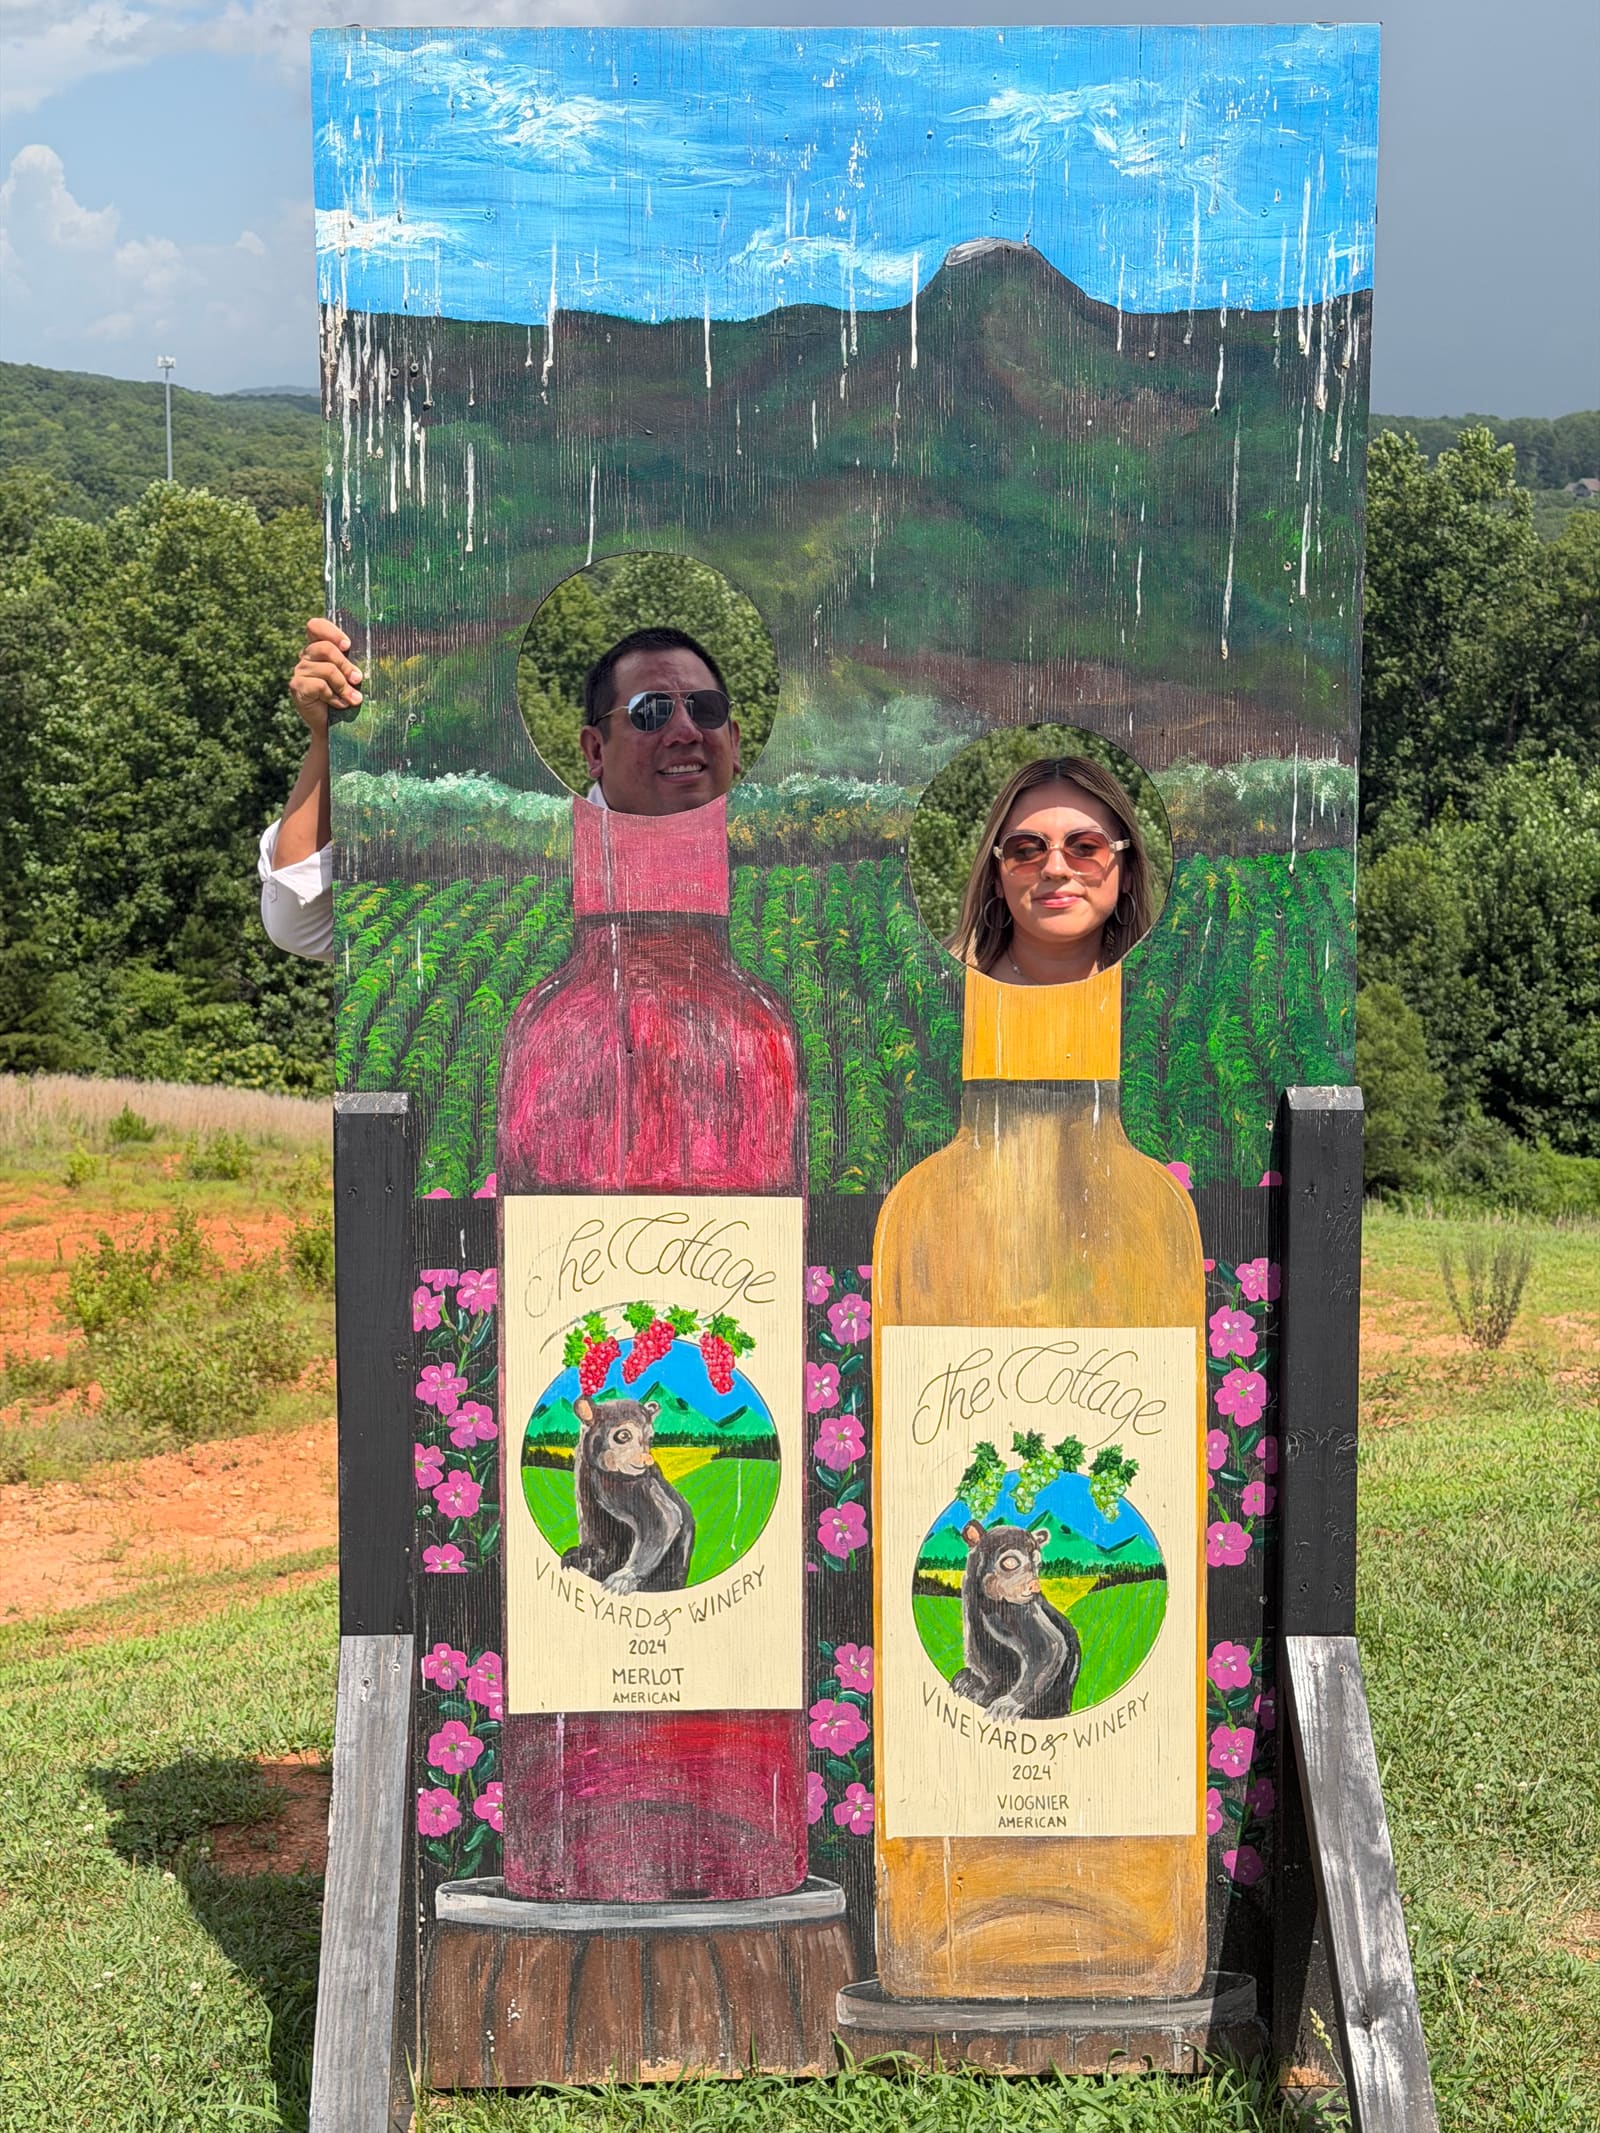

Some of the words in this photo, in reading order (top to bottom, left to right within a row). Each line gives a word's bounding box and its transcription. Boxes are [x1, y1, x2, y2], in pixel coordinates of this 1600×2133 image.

[607, 1212, 777, 1321] Cottage
[912, 1347, 995, 1445] The
[997, 1340, 1167, 1450] Cottage
[535, 1557, 651, 1629] VINEYARD
[653, 1607, 682, 1636] &
[688, 1564, 765, 1624] WINERY
[628, 1639, 667, 1655] 2024
[612, 1667, 685, 1685] MERLOT
[612, 1690, 681, 1704] AMERICAN
[922, 1681, 1037, 1755] VINEYARD
[1040, 1733, 1068, 1760] &
[1073, 1691, 1150, 1749] WINERY
[1012, 1764, 1052, 1780] 2024
[996, 1794, 1070, 1811] VIOGNIER
[998, 1815, 1067, 1828] AMERICAN
